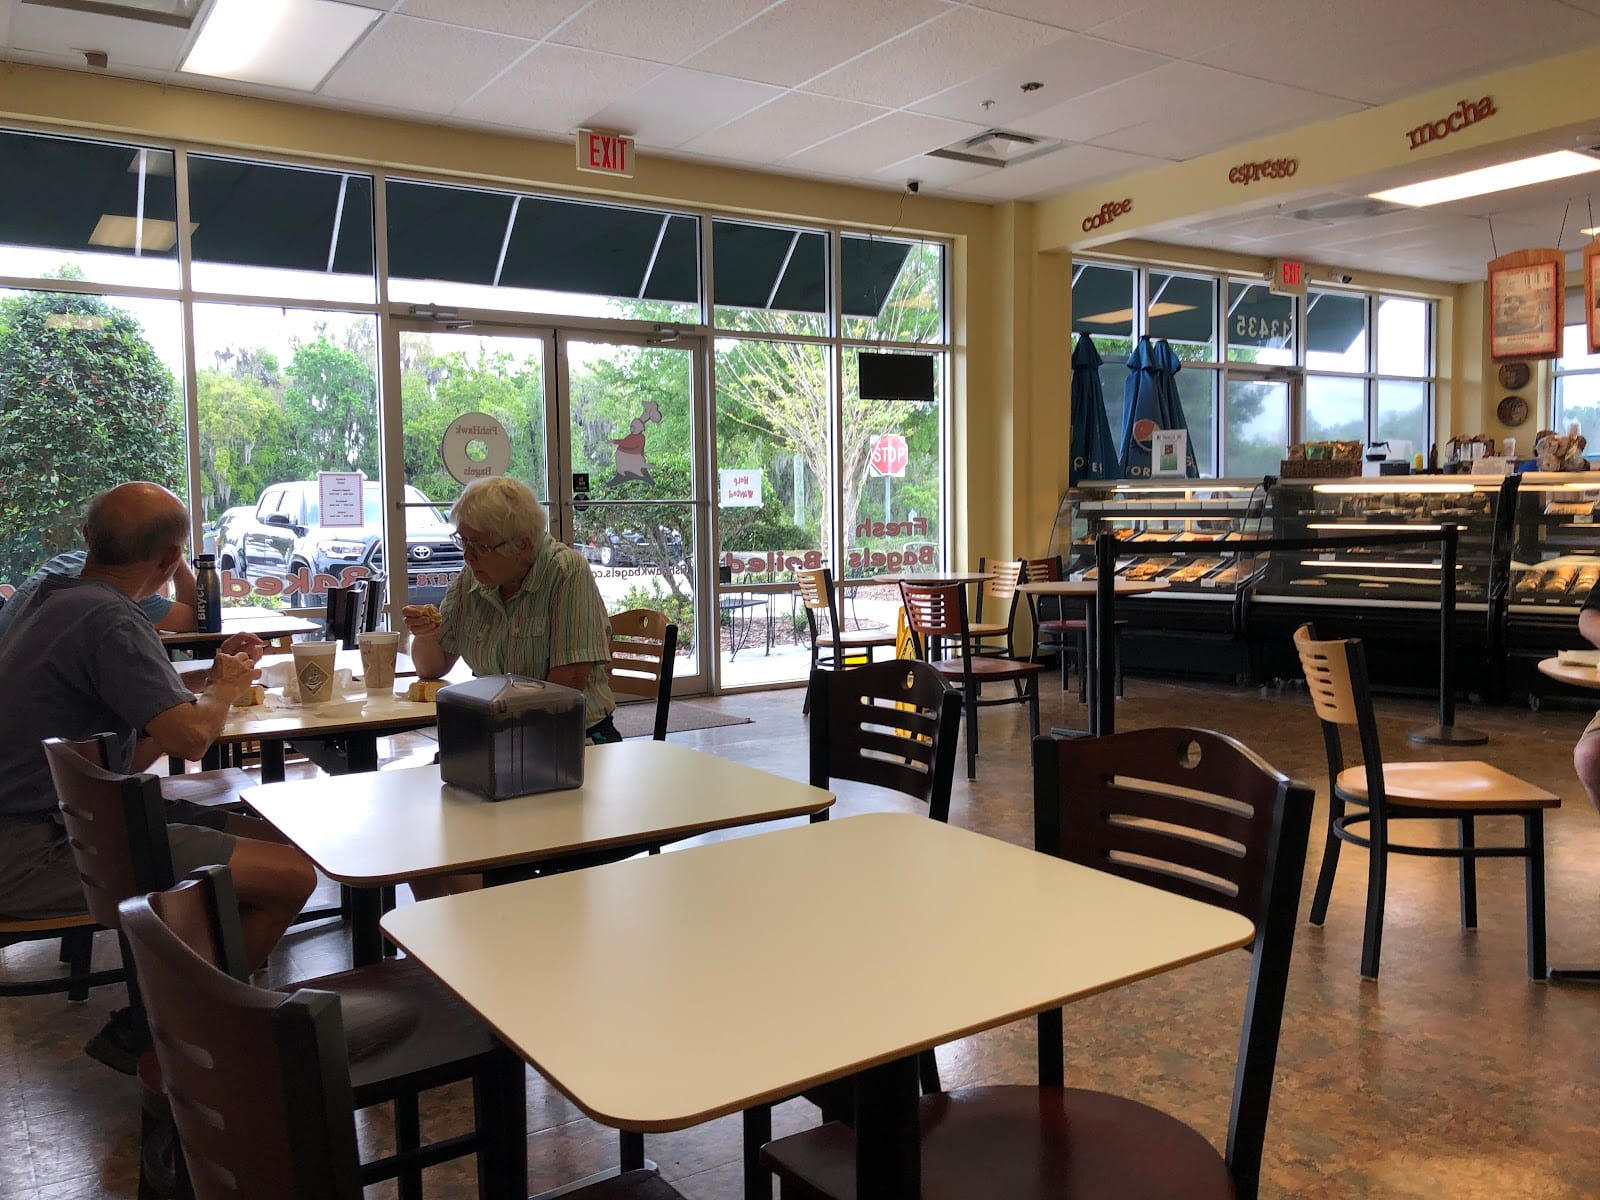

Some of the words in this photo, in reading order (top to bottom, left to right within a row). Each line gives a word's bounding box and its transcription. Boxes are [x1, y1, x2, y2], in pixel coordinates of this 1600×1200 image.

[1406, 96, 1498, 151] mocha
[589, 134, 627, 171] EXIT
[1228, 158, 1298, 186] espresso
[1081, 198, 1133, 232] coffee
[1282, 261, 1302, 285] EXIT
[873, 446, 906, 463] STOP
